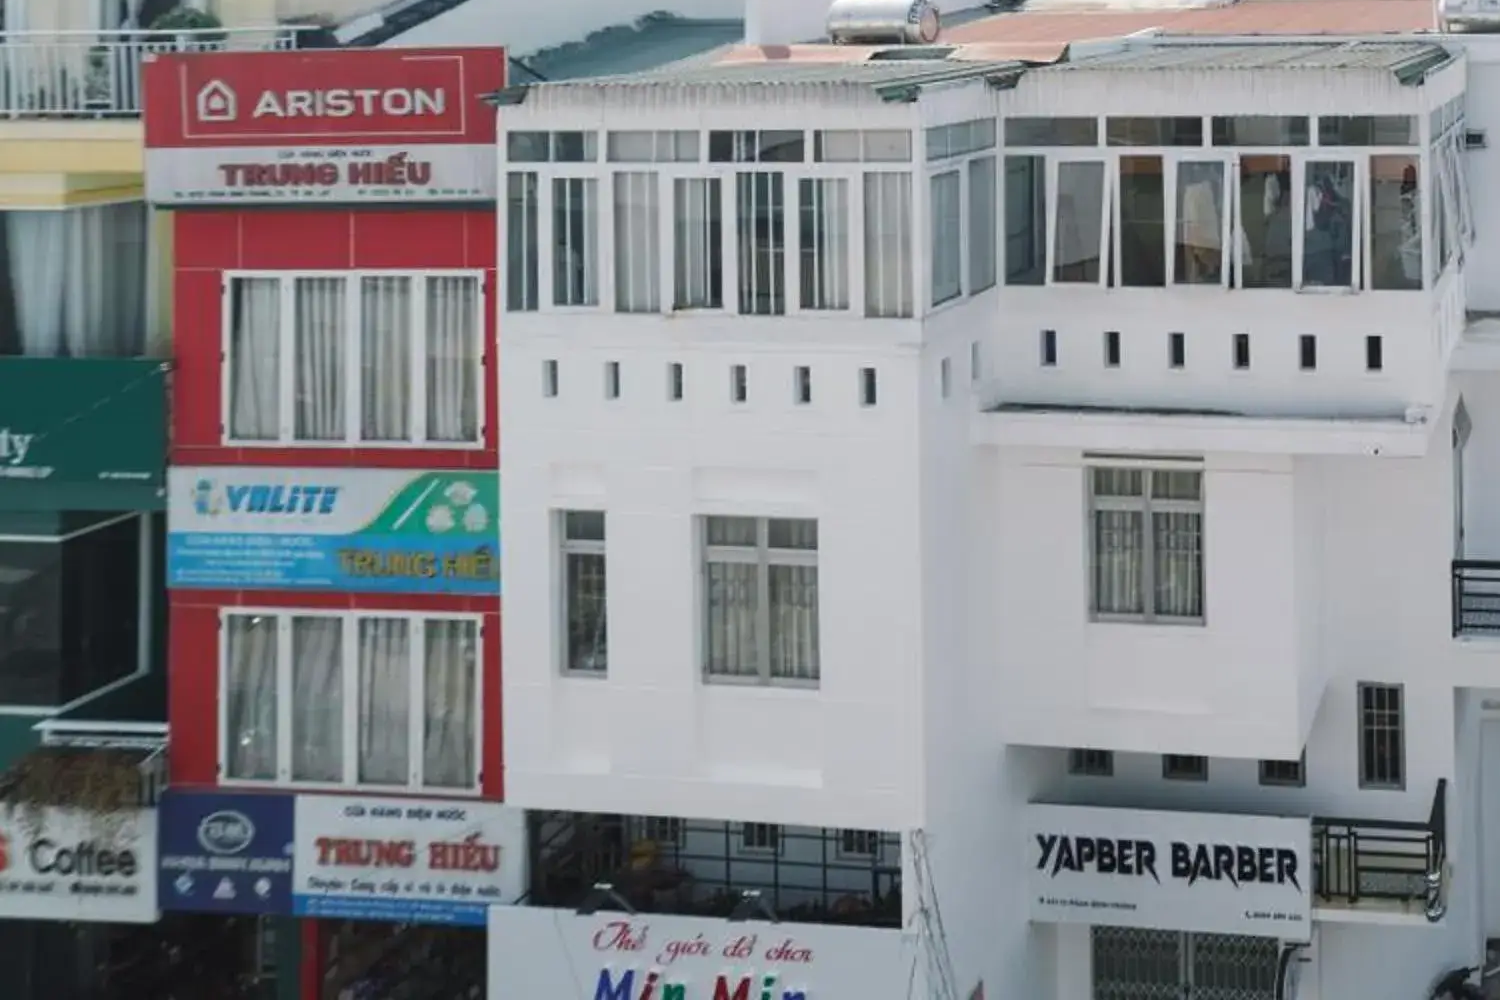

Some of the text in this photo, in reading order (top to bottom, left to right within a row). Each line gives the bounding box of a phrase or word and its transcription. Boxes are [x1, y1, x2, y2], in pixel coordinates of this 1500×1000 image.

[253, 87, 446, 118] ARISTON
[218, 151, 432, 187] TRUNG HIẾU
[337, 548, 436, 579] TRUNG
[29, 838, 137, 877] Coffee
[315, 837, 415, 868] TRUNG
[428, 832, 502, 872] HIẾU
[1035, 834, 1303, 894] YAPBER BARBER
[593, 921, 650, 951] Thế
[656, 933, 711, 966] giới
